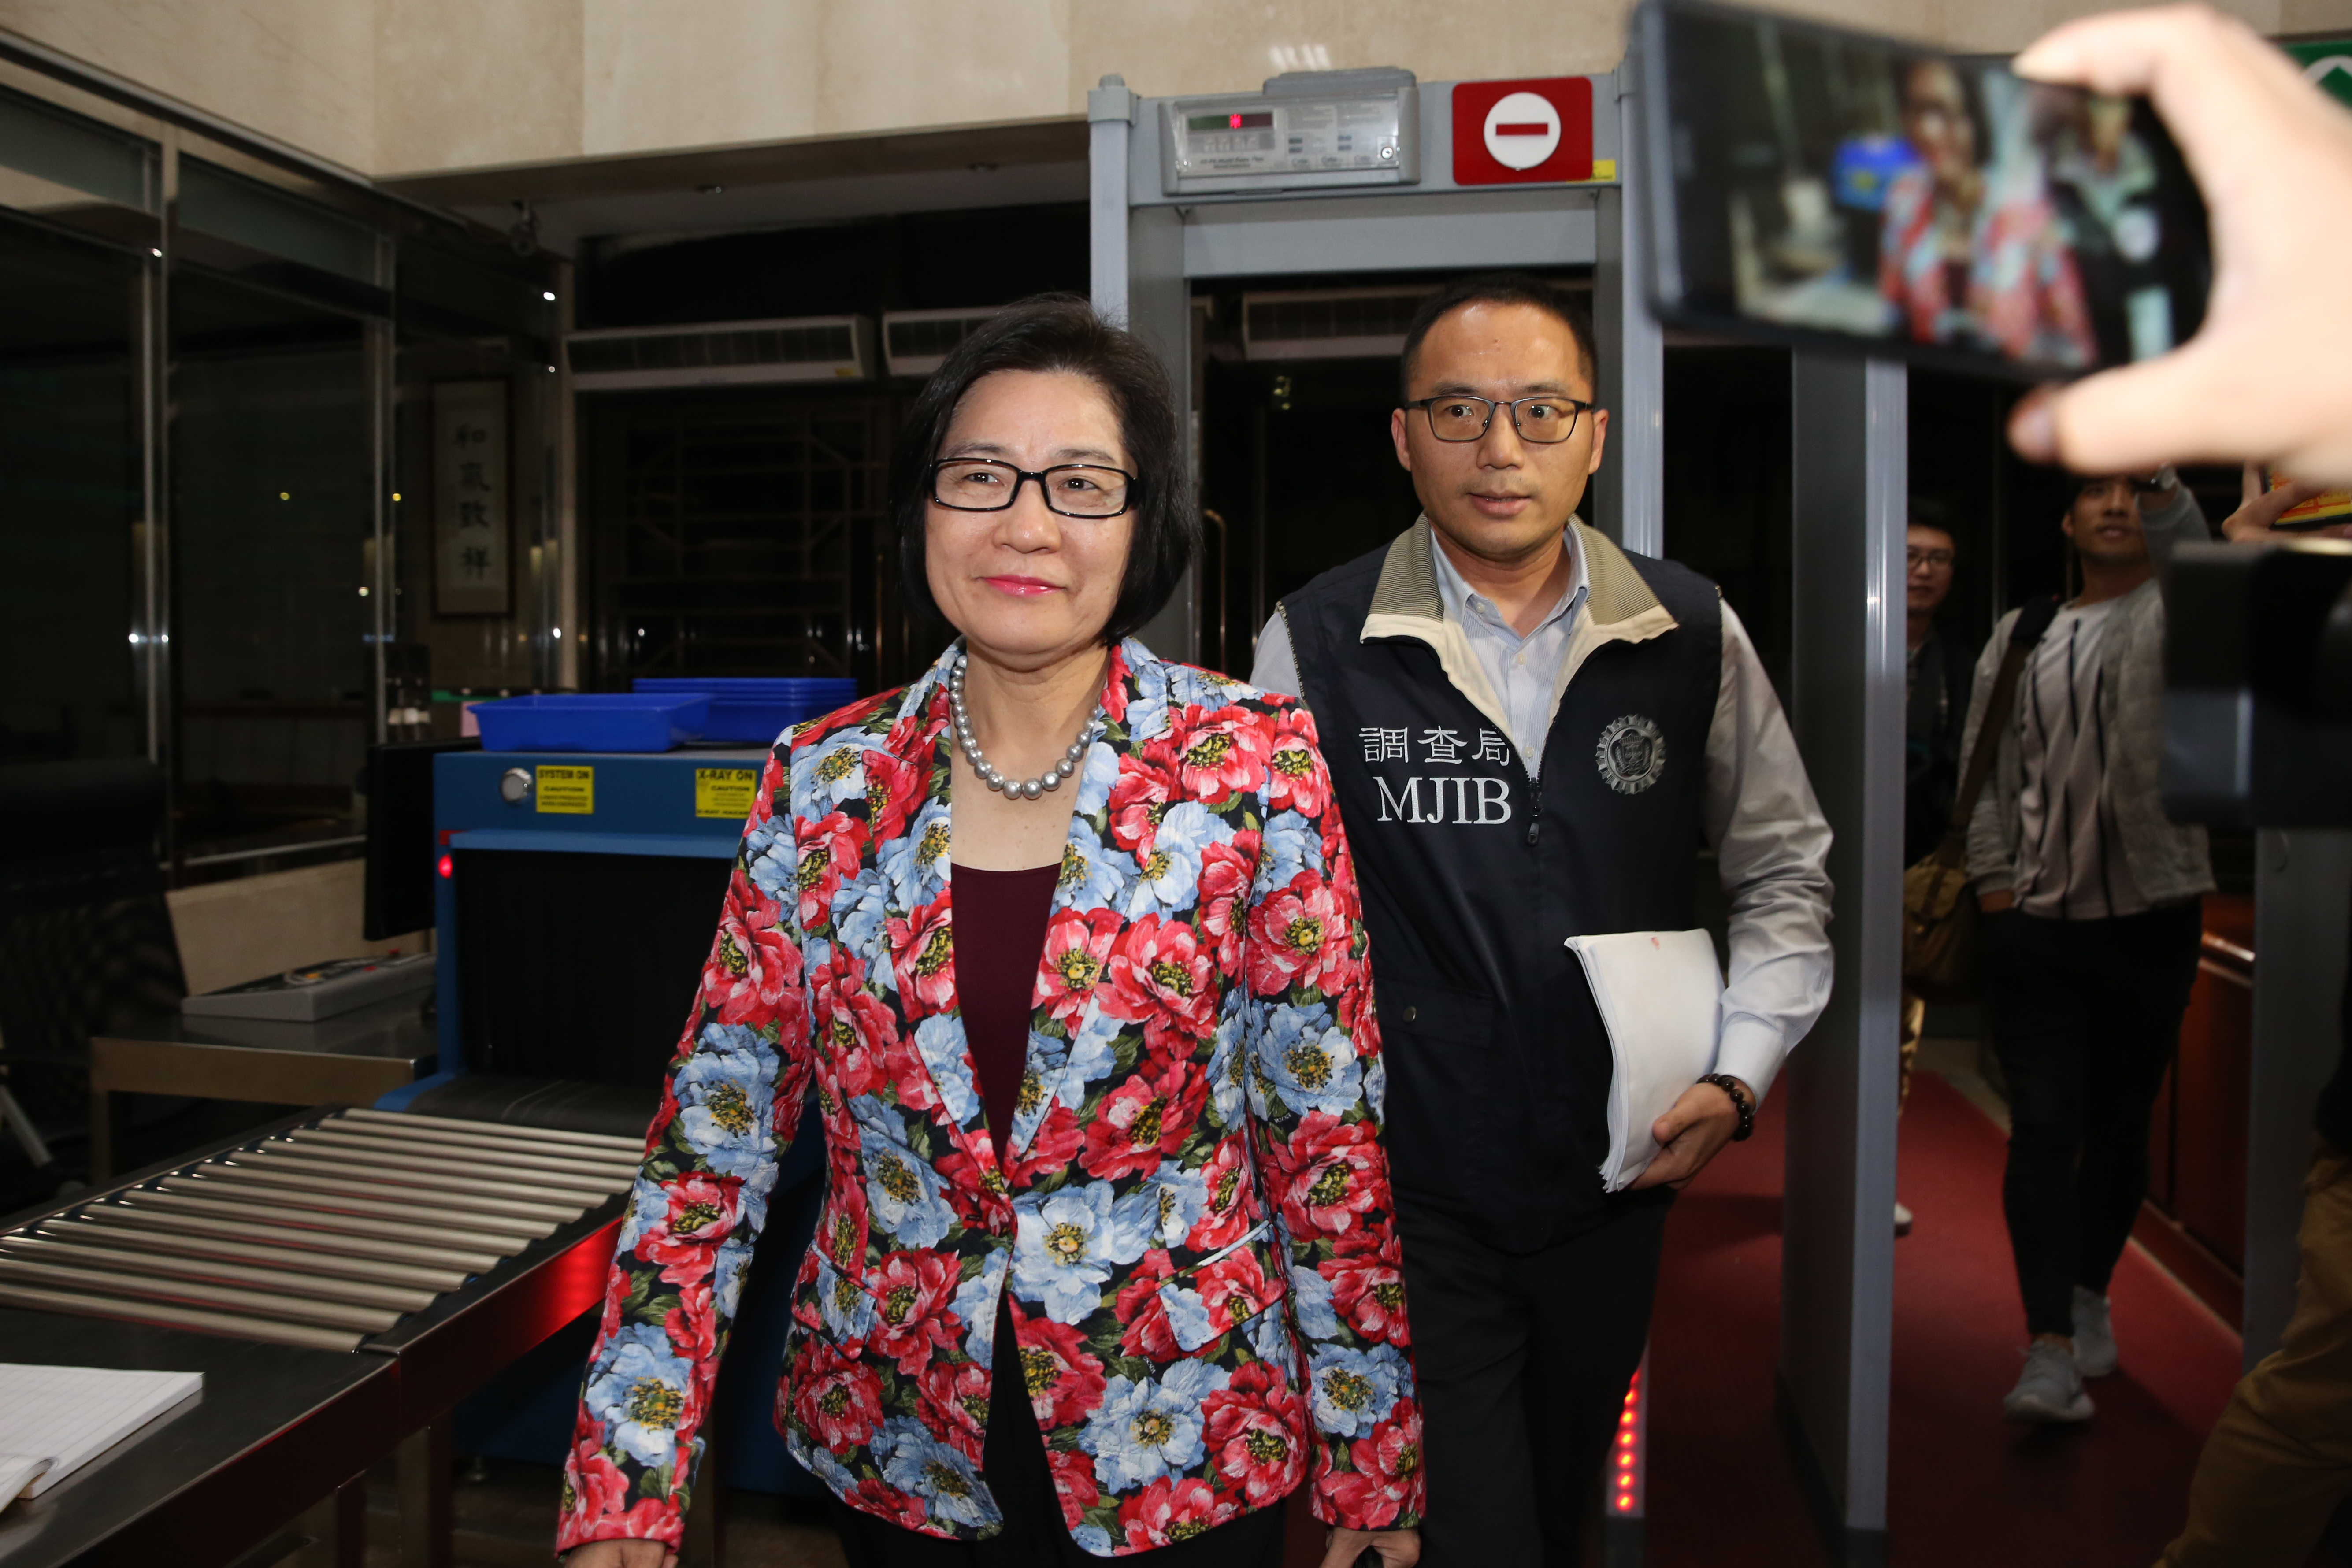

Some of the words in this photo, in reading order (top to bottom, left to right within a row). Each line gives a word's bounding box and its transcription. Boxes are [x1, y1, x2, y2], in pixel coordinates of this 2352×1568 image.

[1358, 725, 1510, 766] 調查局
[538, 770, 573, 779] SYSTEM
[577, 771, 590, 779] ON
[698, 769, 731, 779] X-RAY
[736, 771, 753, 780] ON
[1372, 776, 1511, 824] MJIB
